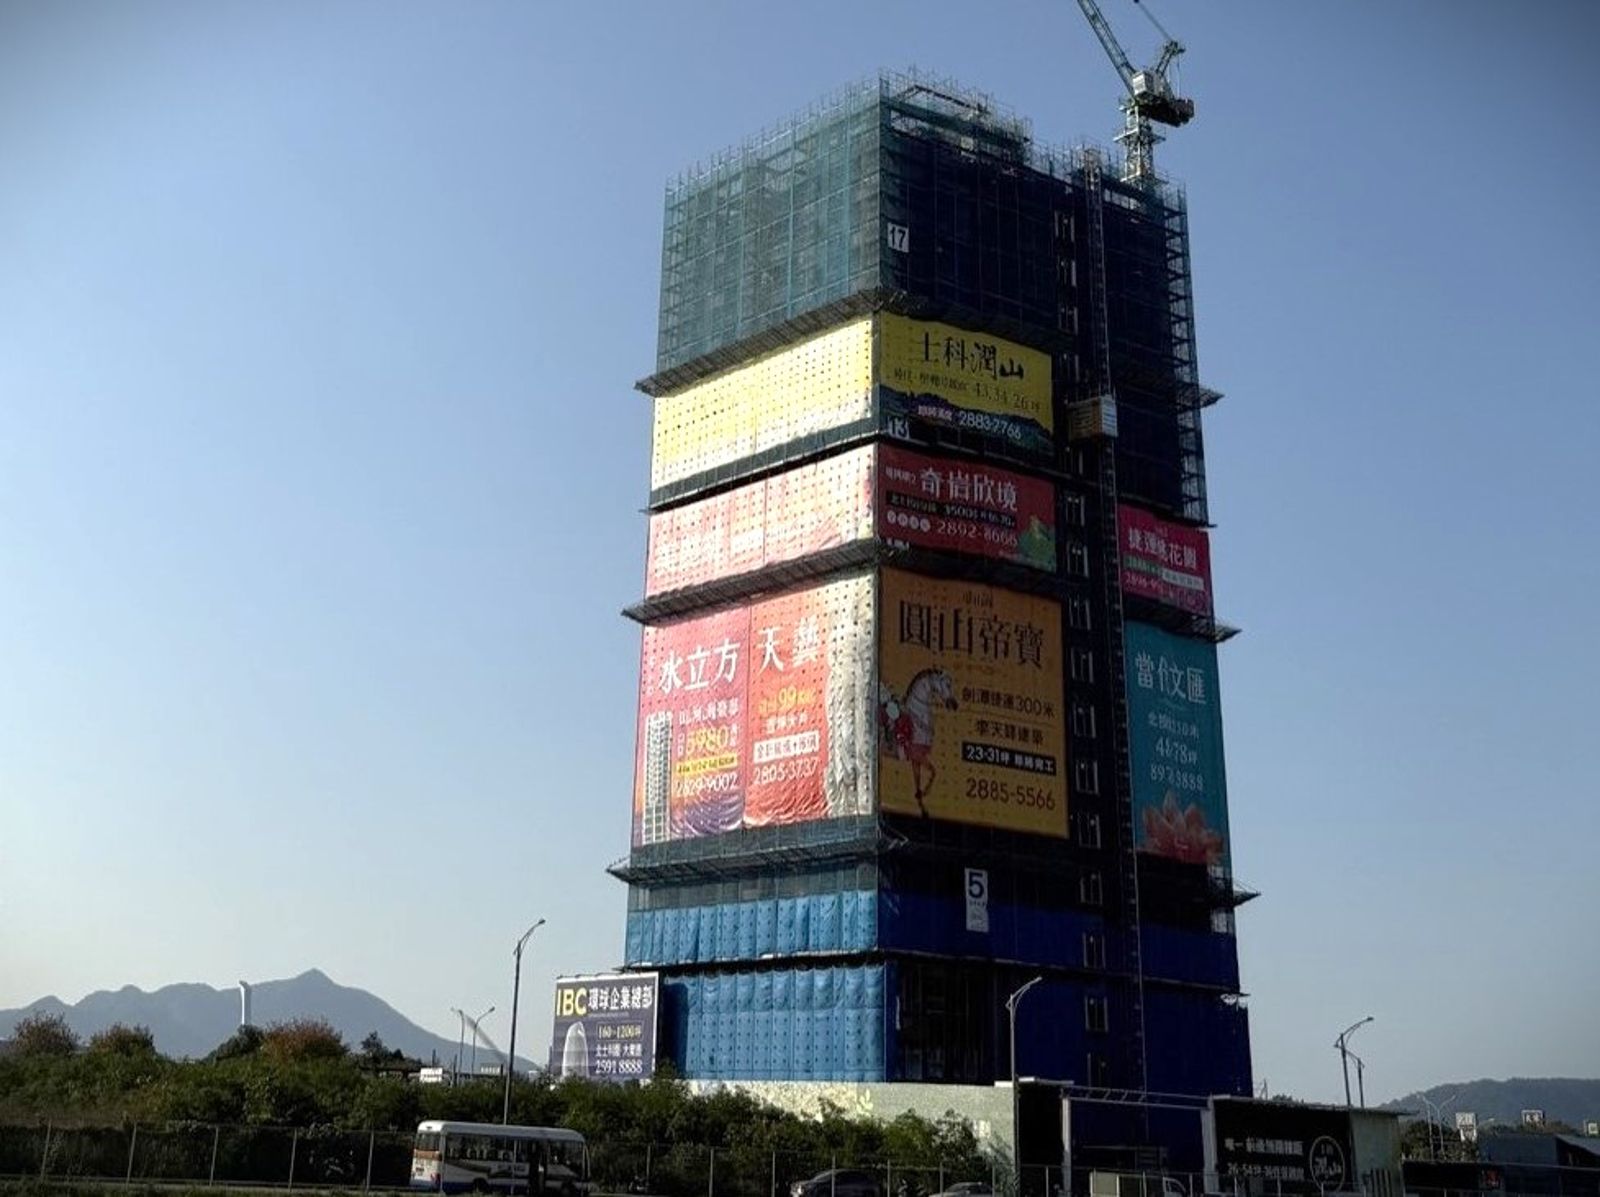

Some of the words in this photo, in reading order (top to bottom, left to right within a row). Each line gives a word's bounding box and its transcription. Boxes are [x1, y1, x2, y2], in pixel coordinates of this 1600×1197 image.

[889, 226, 906, 249] 17
[908, 332, 1025, 381] 士科潤山
[899, 600, 1045, 670] 圓山帝寶
[659, 638, 741, 695] 水立方
[1134, 650, 1207, 705] 當代文匯
[686, 725, 729, 757] 5980
[965, 777, 1056, 811] 2885-5566
[968, 872, 984, 898] 5
[556, 987, 588, 1017] IBC
